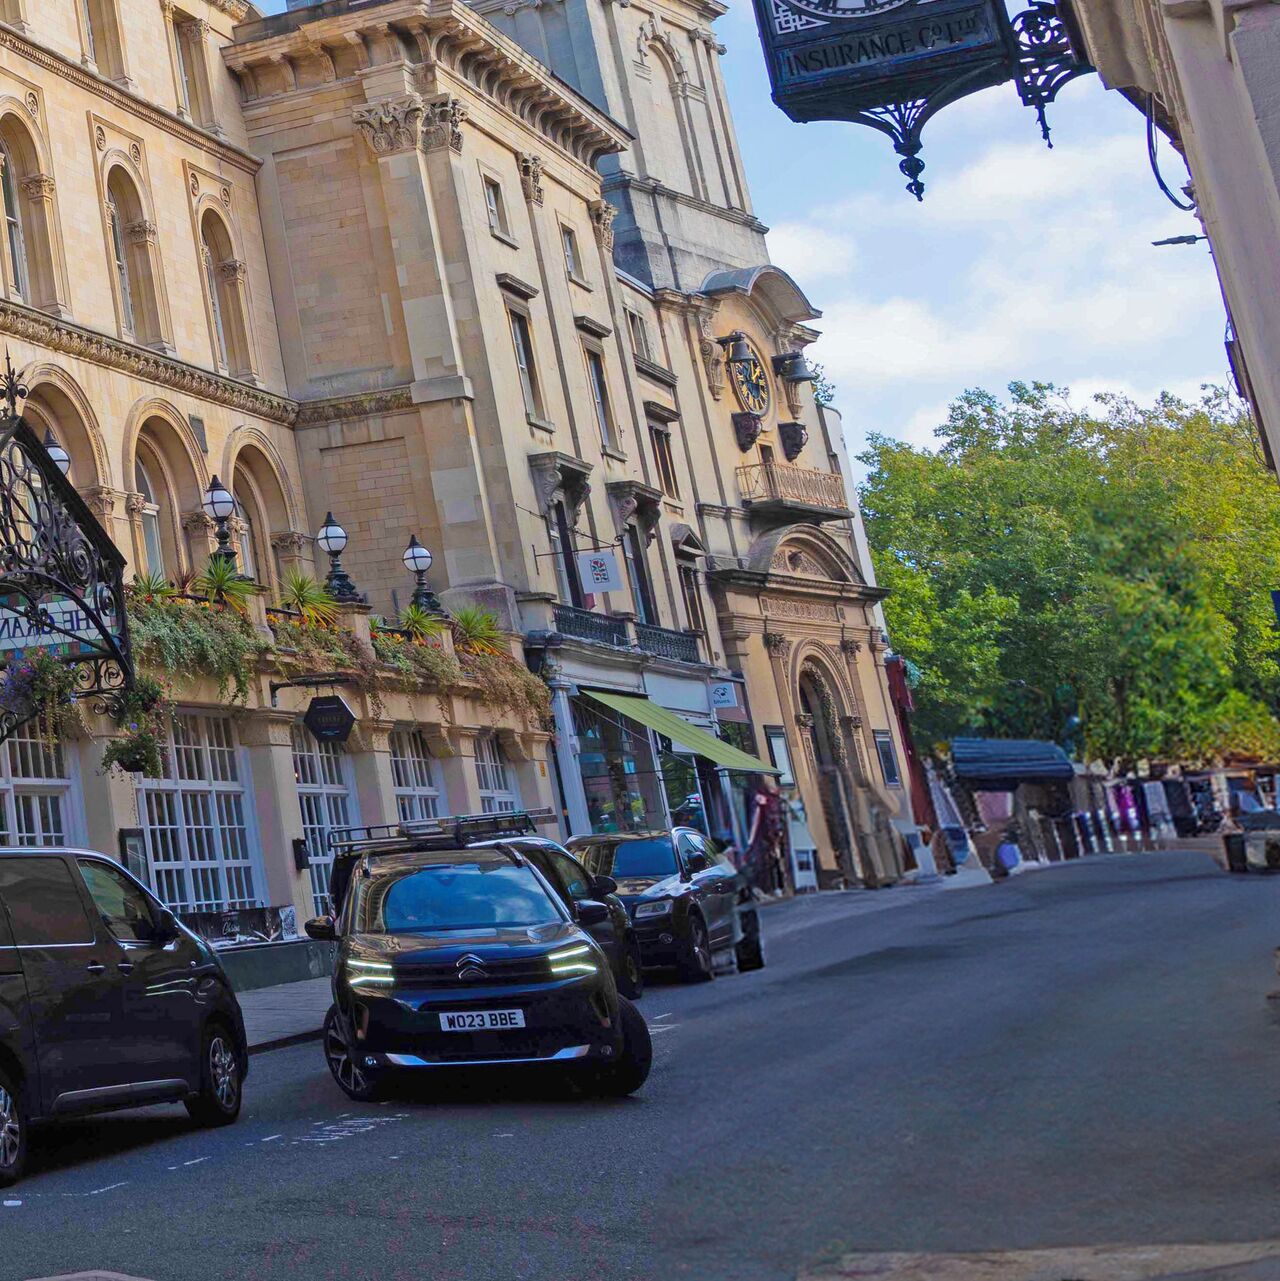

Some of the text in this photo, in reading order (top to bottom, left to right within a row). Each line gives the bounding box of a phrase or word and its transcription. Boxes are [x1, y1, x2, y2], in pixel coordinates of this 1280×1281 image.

[787, 30, 916, 75] INSURANCE
[446, 1012, 518, 1029] WO23 BBE
